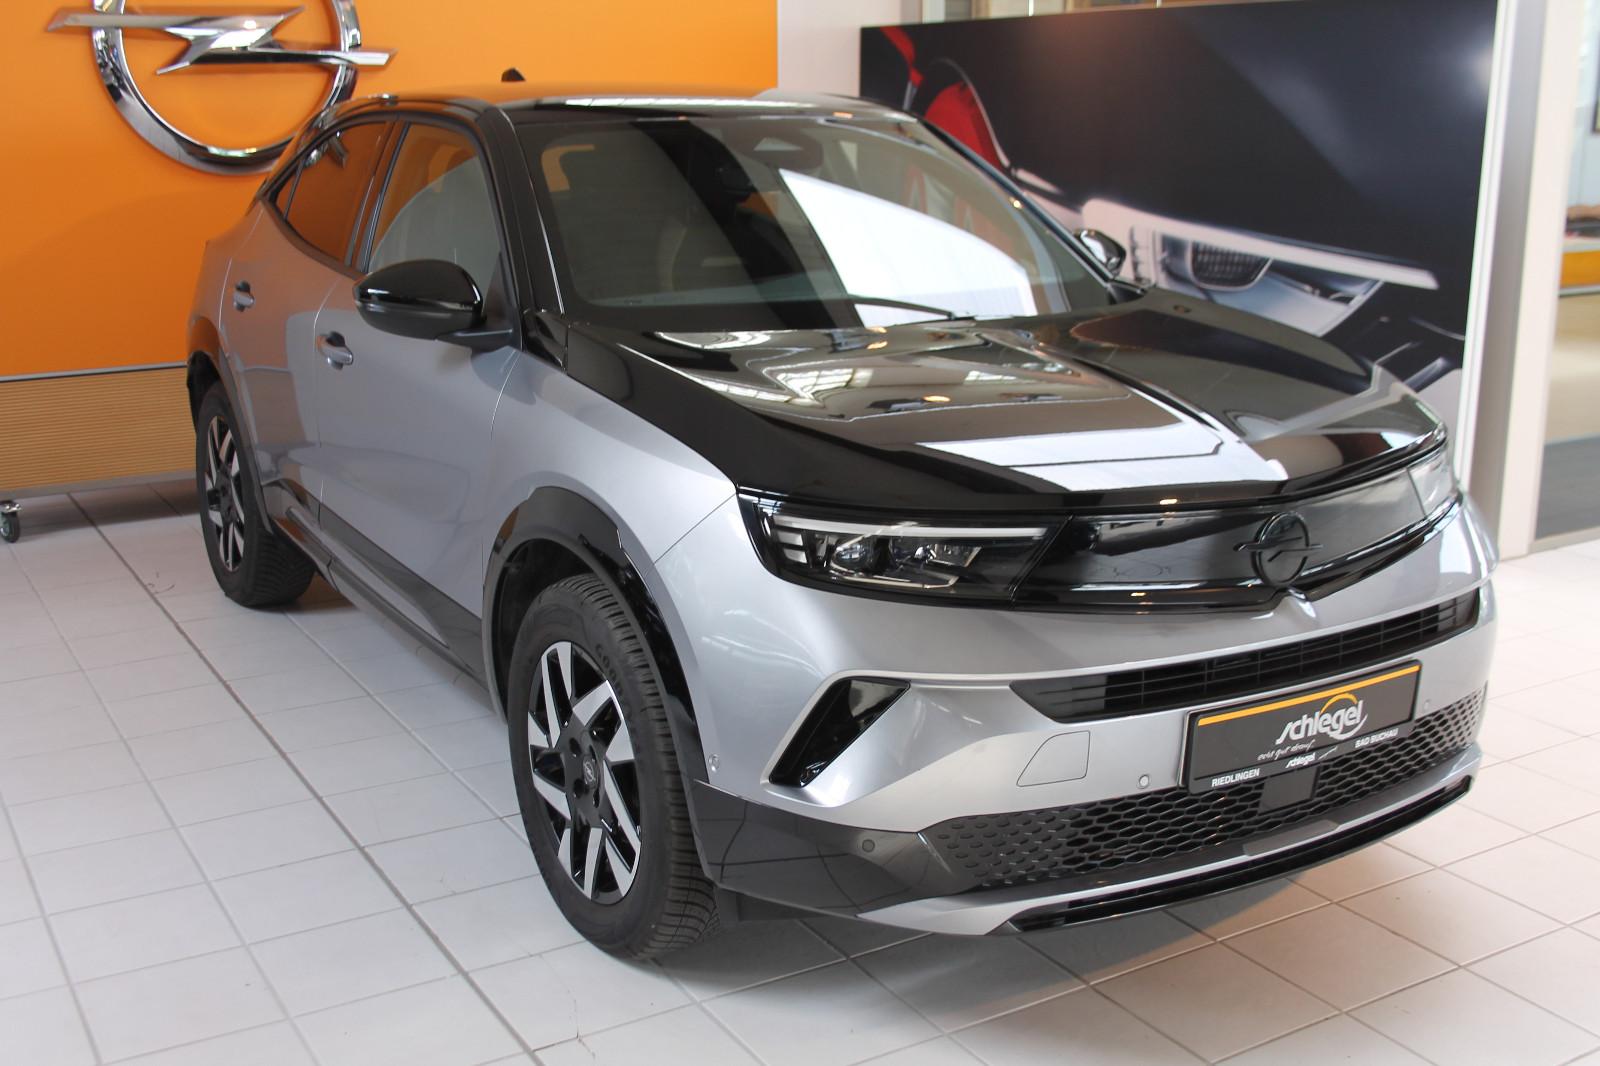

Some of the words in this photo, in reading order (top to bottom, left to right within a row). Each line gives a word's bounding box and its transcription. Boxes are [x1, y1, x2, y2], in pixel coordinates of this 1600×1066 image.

[1211, 767, 1260, 787] RIEDLINGEN
[1355, 737, 1370, 748] BAD
[1370, 728, 1399, 743] BUCHAU
